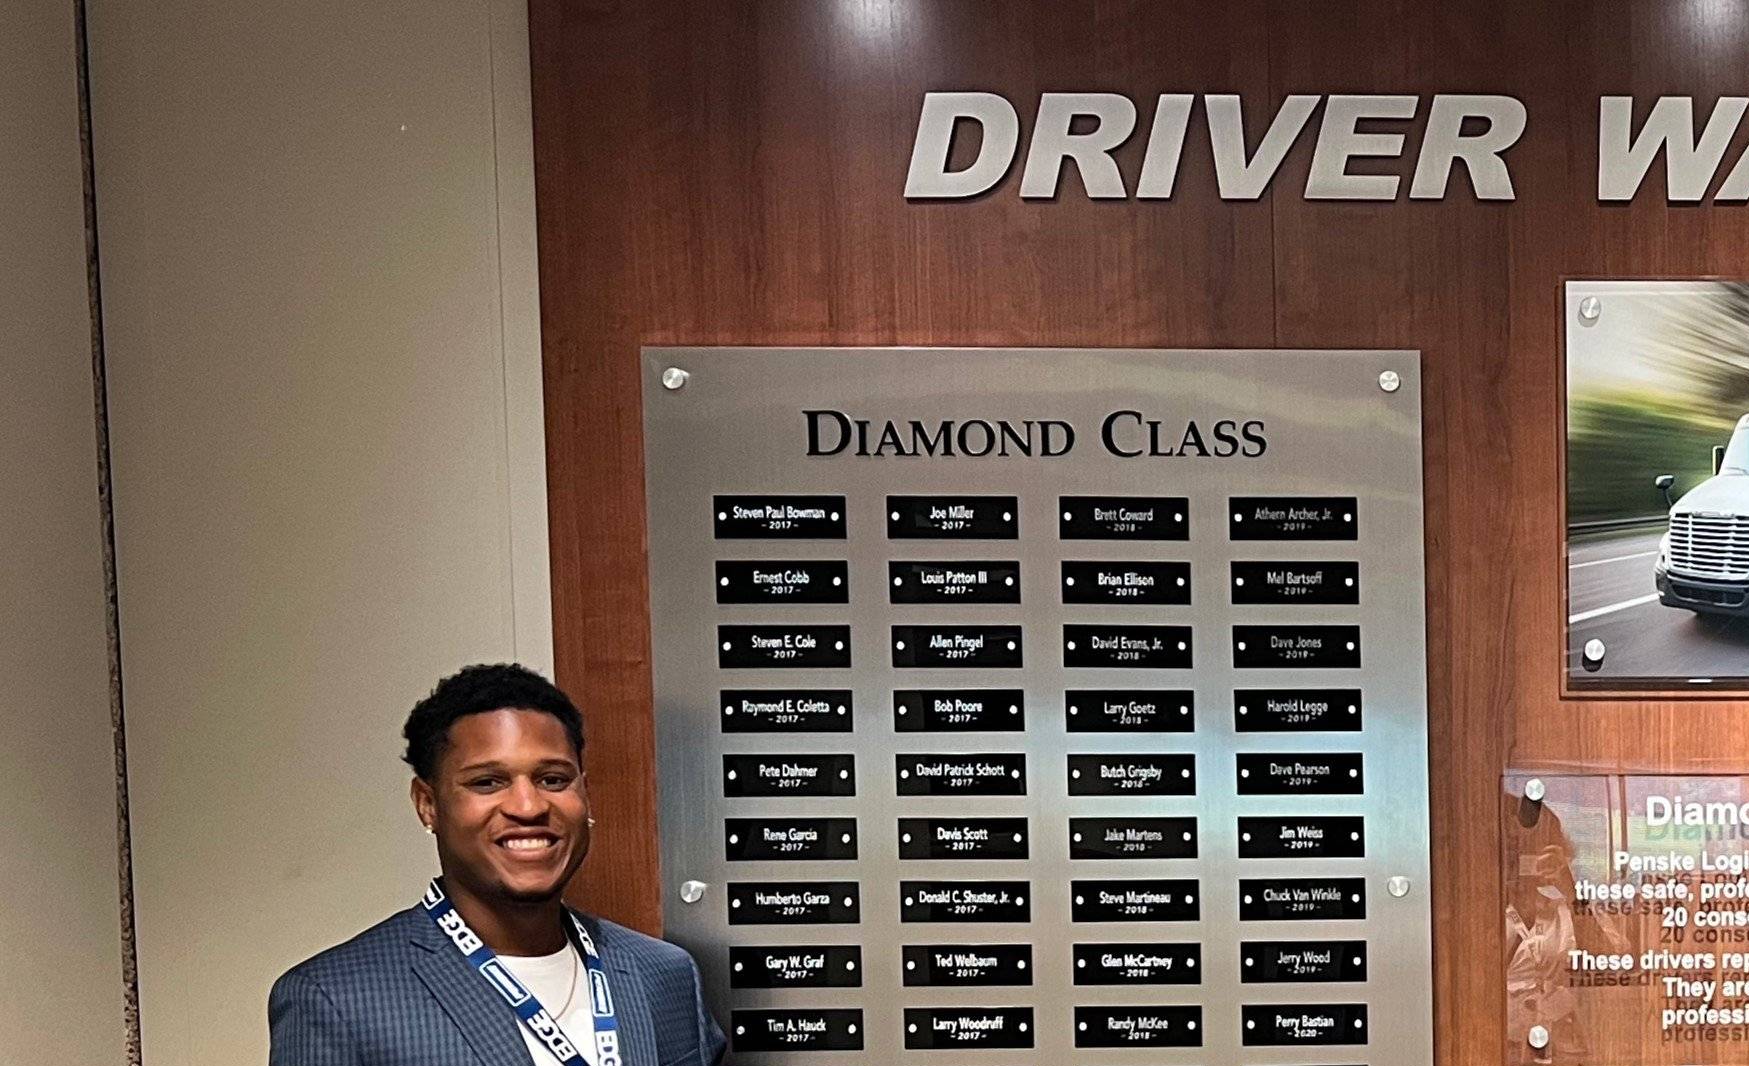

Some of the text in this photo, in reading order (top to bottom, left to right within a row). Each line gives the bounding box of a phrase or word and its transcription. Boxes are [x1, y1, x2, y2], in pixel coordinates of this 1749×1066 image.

[903, 91, 1529, 200] DRIVER
[802, 409, 1268, 458] DIAMOND CLASS
[733, 505, 826, 519] Steven Paul Bowman
[929, 505, 974, 519] Joe Miller
[753, 570, 810, 584] Ernest Cobb
[921, 570, 987, 585] Louis Patton III
[1098, 571, 1154, 587] Brian Ellison
[751, 634, 816, 648] Steven E. Cole
[929, 634, 984, 651] Allen Pingel
[1092, 635, 1163, 651] David Evans, Jr.
[934, 699, 954, 713] Bob
[1104, 701, 1128, 718] Larry
[759, 763, 818, 777] Pete Dahmer
[1100, 764, 1126, 778] Butch
[1270, 762, 1330, 775] Dave Pearson
[763, 827, 787, 841] Rene
[963, 826, 988, 841] Scott
[1279, 826, 1324, 839] Jim Weiss
[1613, 851, 1695, 872] Penske
[803, 891, 830, 905] Garza
[1575, 880, 1636, 900] these
[1641, 880, 1694, 901] safe,
[1662, 907, 1688, 927] 20
[766, 955, 788, 971] Gary
[789, 955, 802, 969] W.
[935, 953, 998, 967] Ted Welbaum
[1277, 950, 1331, 968] Jerry Wood
[1568, 950, 1634, 971] These
[1640, 949, 1716, 970] drivers
[1662, 977, 1716, 1001] They
[933, 1015, 1004, 1033] Larry Woodruff
[1108, 1016, 1169, 1032] Randy McKee
[1276, 1014, 1334, 1031] Perry Bastian
